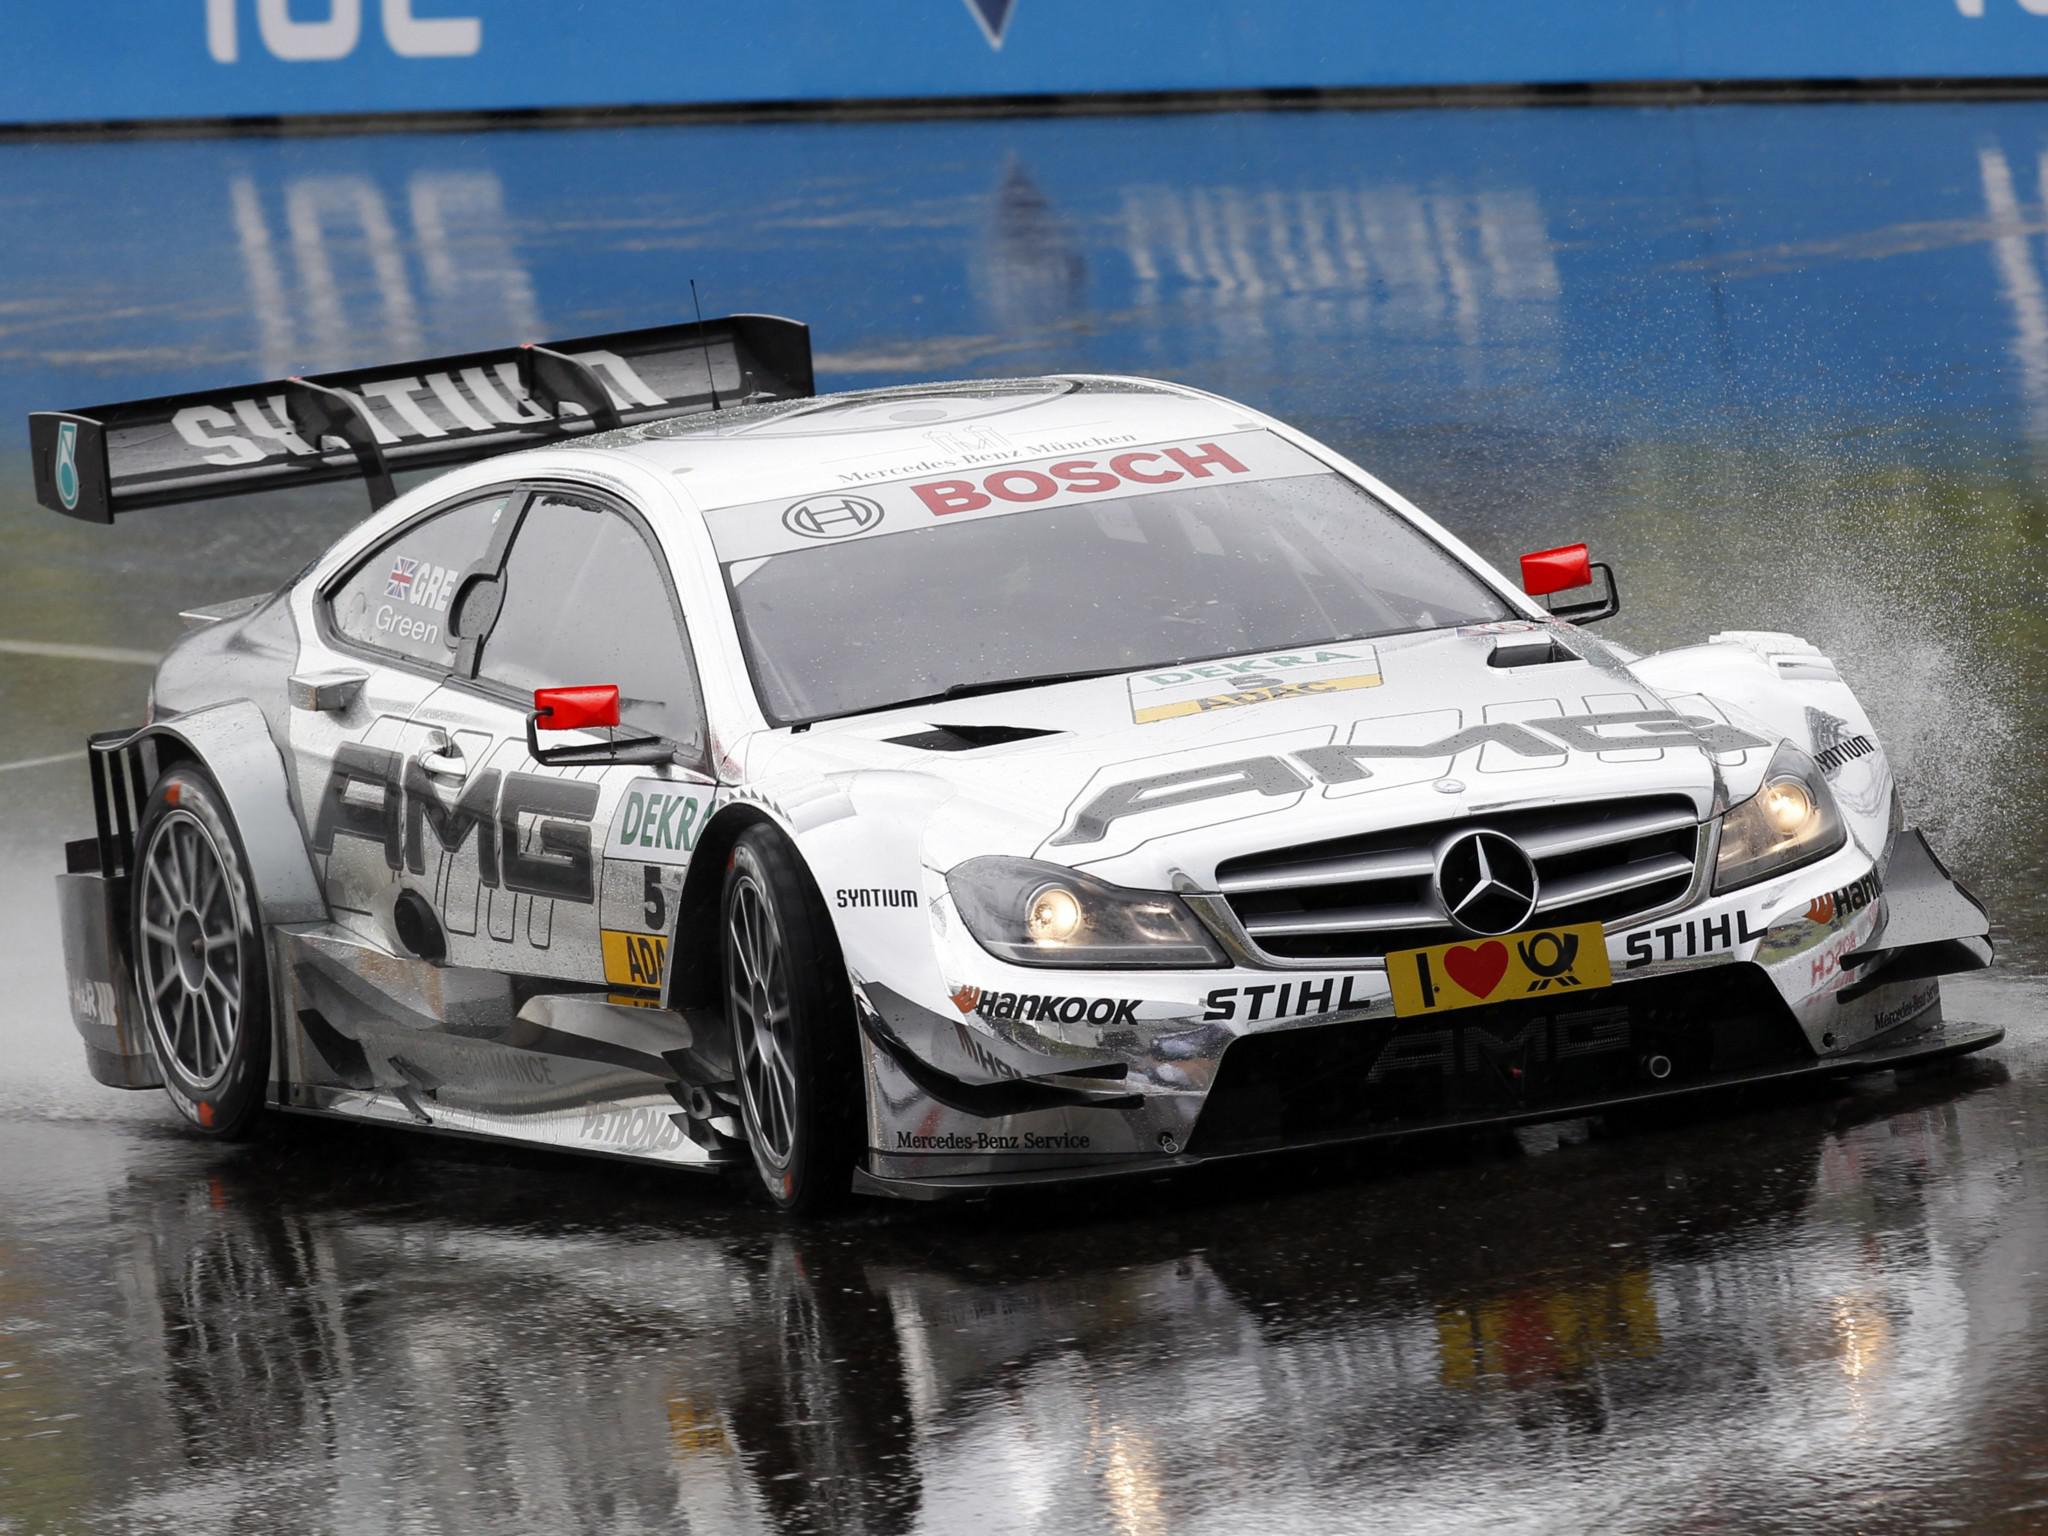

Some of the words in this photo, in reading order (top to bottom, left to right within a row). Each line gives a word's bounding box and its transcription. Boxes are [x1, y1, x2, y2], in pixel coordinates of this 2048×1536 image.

[838, 447, 1021, 485] Mercedes-Benz
[1023, 434, 1138, 457] München
[910, 443, 1250, 516] BOSCH
[410, 562, 458, 612] GRE
[375, 604, 438, 645] Green
[1145, 651, 1361, 686] DEKRA
[1226, 674, 1284, 690] 5
[1198, 681, 1337, 711] ADAC
[1049, 710, 1772, 846] AMG
[313, 740, 600, 904] AMG
[644, 865, 666, 931] 5
[837, 889, 918, 908] SYNTIUM
[1626, 909, 1768, 970] STIHL
[975, 990, 1143, 1025] Hankook
[1203, 976, 1371, 1021] STIHL
[1367, 1005, 1631, 1084] AMG
[896, 1131, 1018, 1150] Mercedes-Benz
[1023, 1132, 1090, 1150] Service
